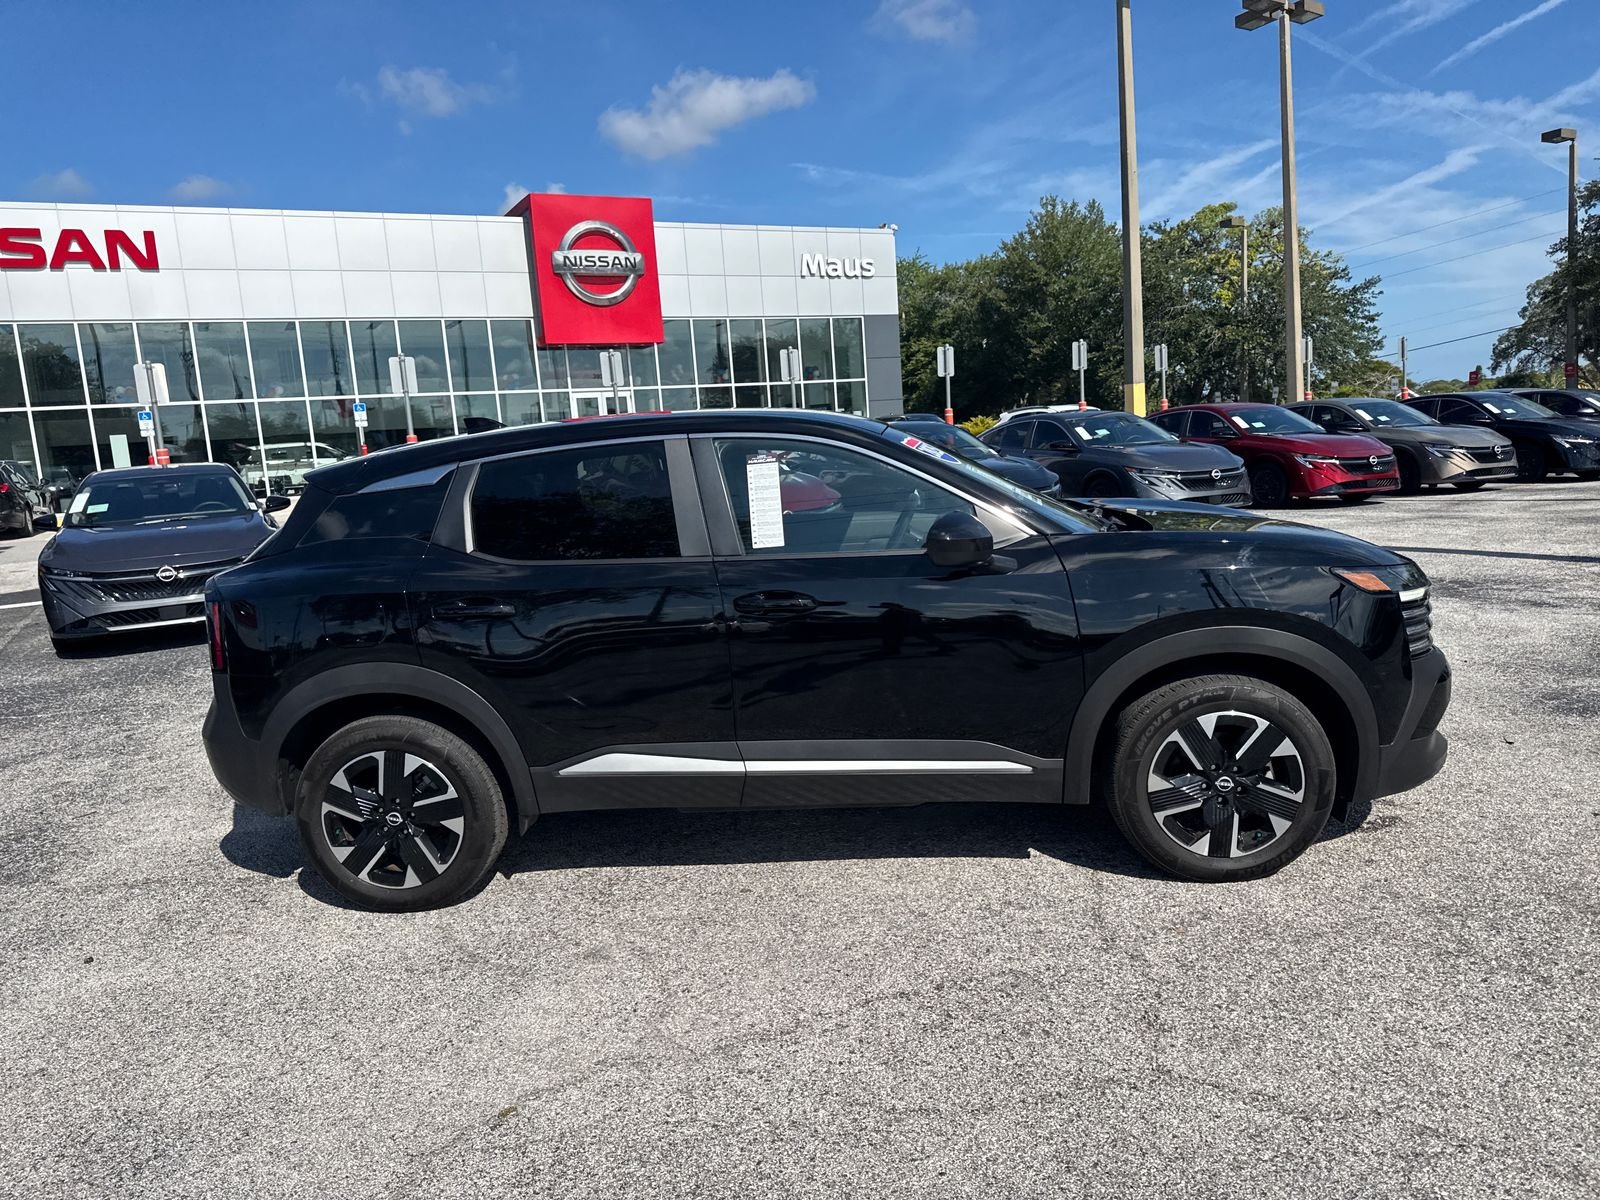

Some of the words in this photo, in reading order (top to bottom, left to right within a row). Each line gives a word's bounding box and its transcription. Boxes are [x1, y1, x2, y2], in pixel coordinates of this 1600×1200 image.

[563, 255, 637, 269] NISSAN
[801, 253, 875, 278] Maus
[1179, 695, 1201, 710] PT
